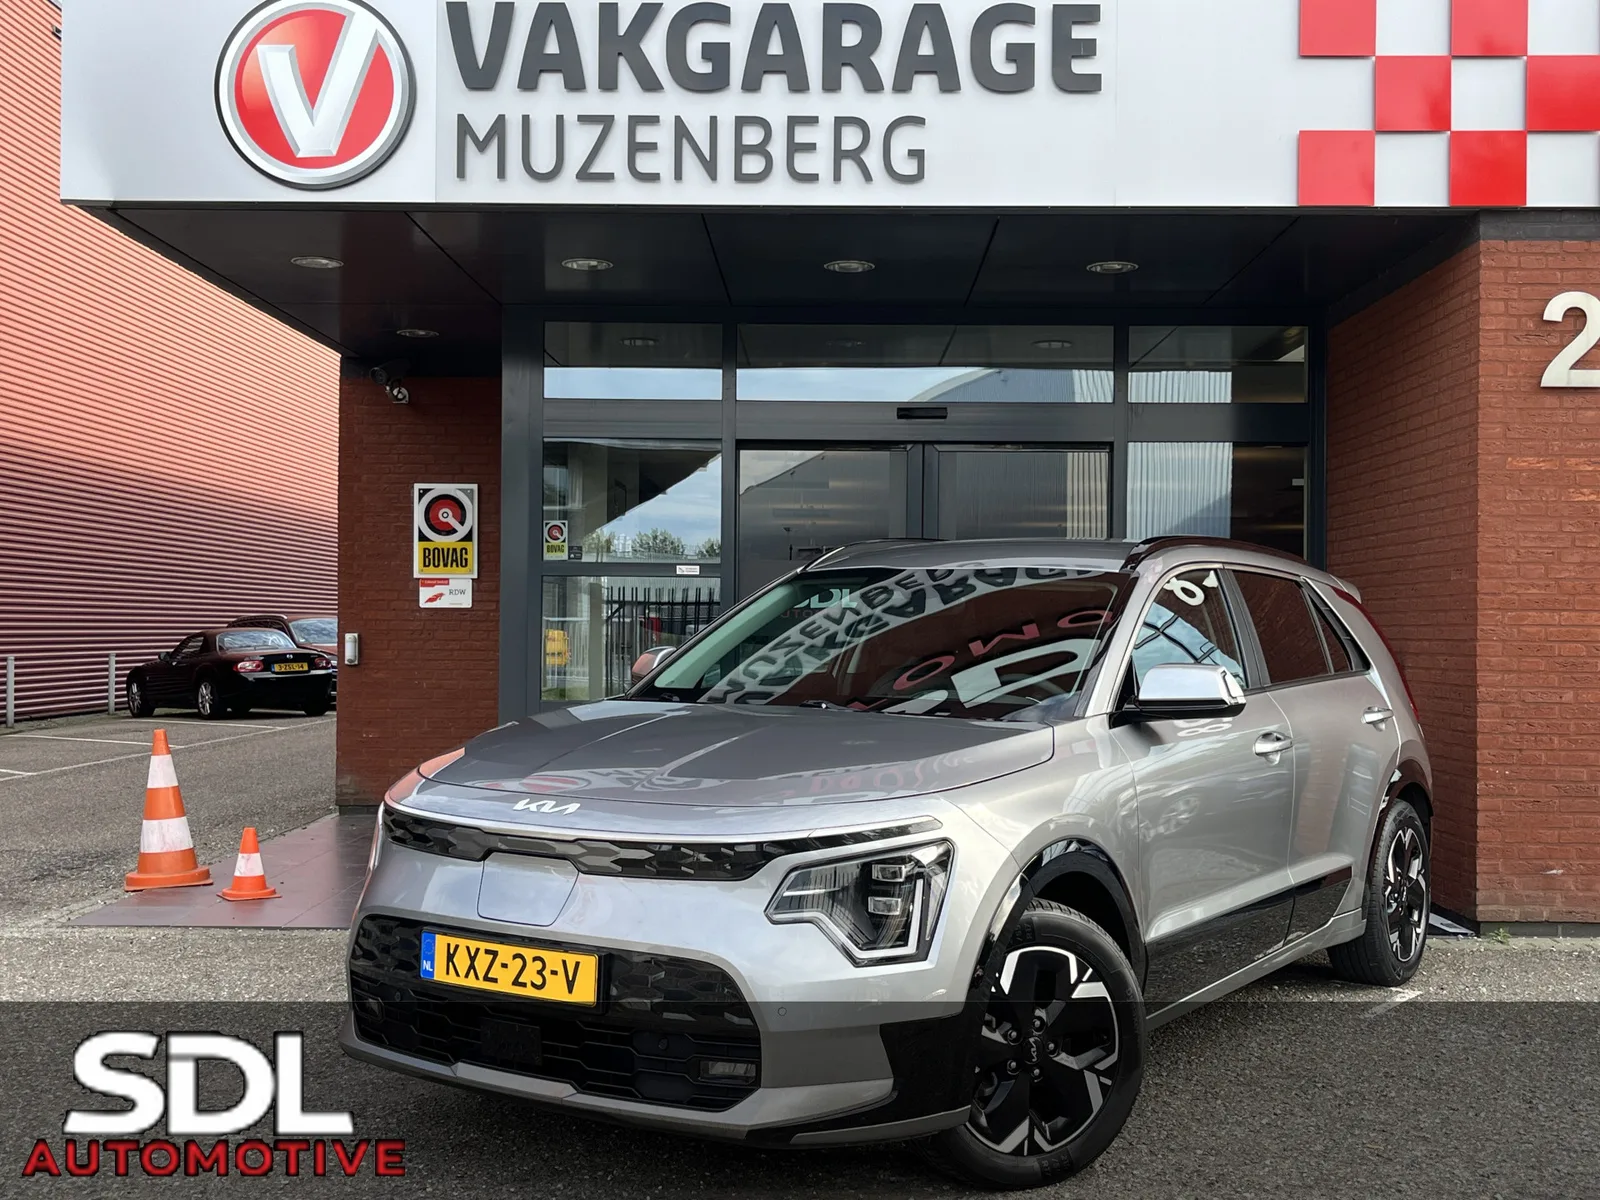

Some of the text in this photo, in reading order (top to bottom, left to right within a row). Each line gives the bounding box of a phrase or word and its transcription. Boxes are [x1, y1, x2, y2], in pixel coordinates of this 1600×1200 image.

[445, 2, 1102, 94] VAKGARAGE
[456, 113, 927, 184] MUZENBERG
[1541, 291, 1600, 388] 2
[422, 546, 469, 569] BOVAG
[546, 544, 565, 553] BOVAG
[448, 588, 466, 596] RDW
[422, 959, 434, 972] NL
[445, 942, 581, 995] KXZ-23-V
